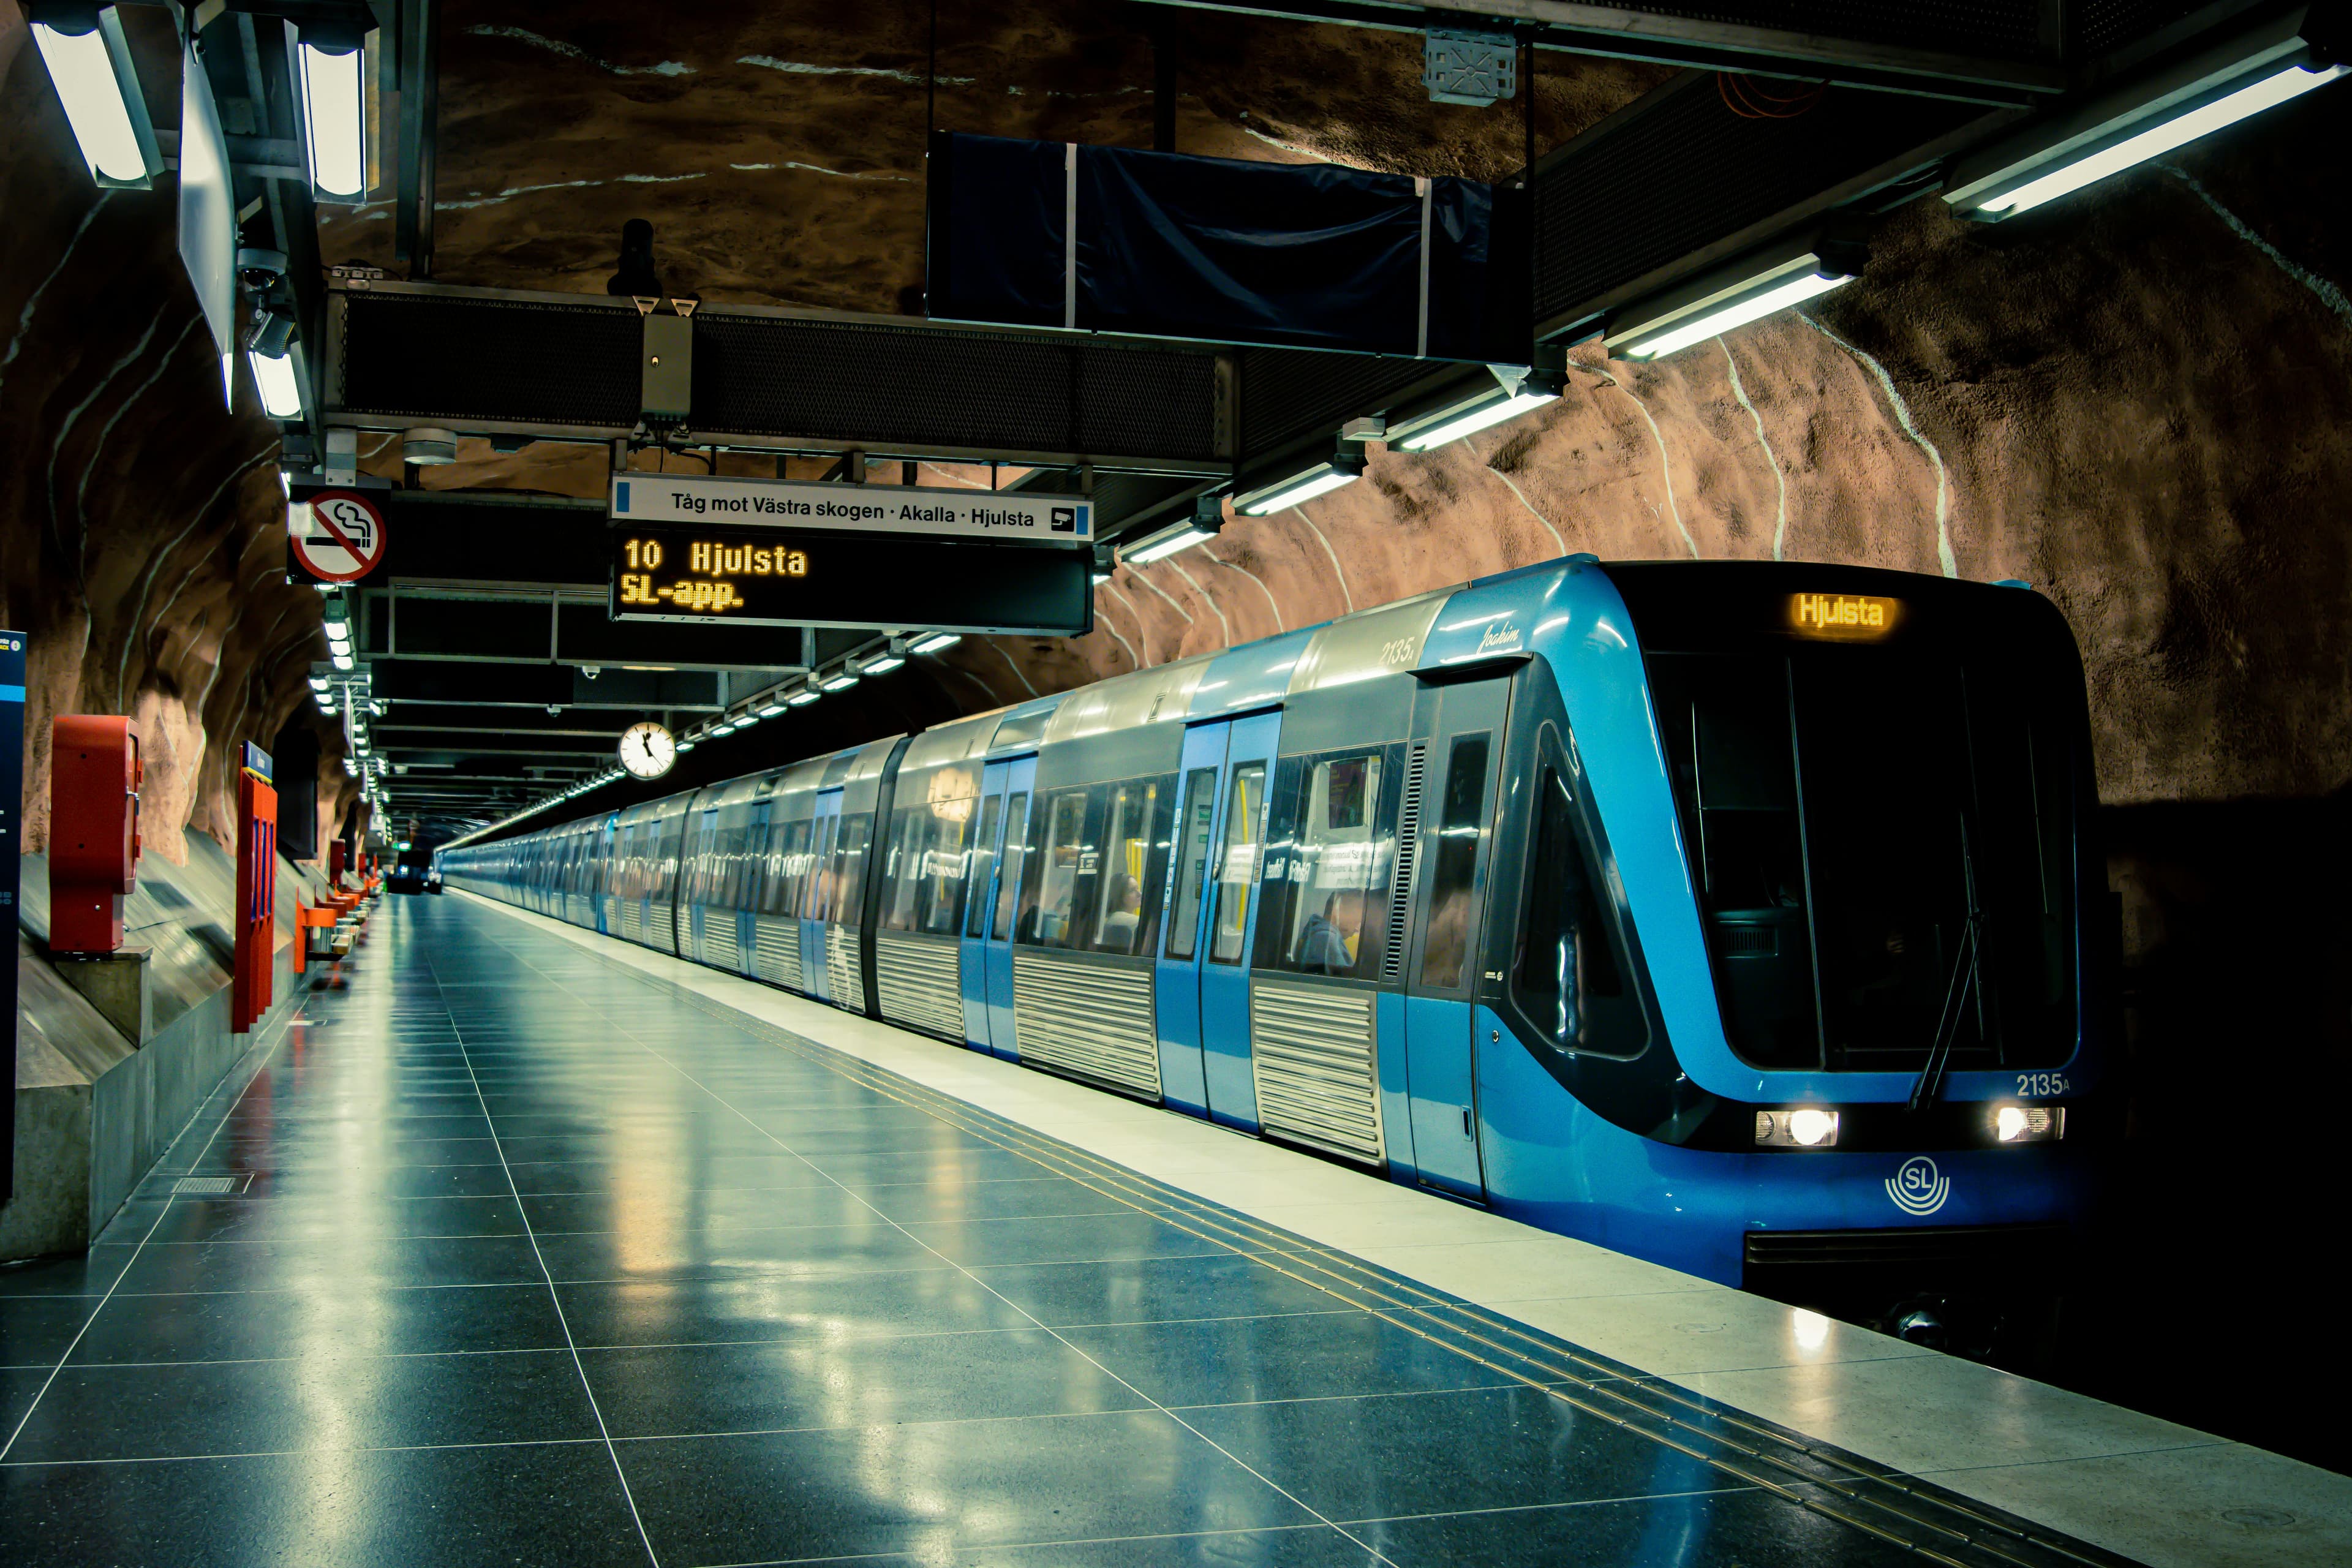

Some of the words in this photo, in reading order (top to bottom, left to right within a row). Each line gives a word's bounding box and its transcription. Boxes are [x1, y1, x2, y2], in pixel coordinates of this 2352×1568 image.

[672, 492, 706, 514] Tåg
[712, 497, 748, 513] mot
[753, 497, 810, 516] Västra
[816, 500, 884, 521] skogen
[899, 505, 956, 522] Akalla
[971, 508, 1035, 528] Hjulsta
[625, 537, 662, 570] 10
[691, 541, 807, 578] Hjulsta
[620, 574, 744, 611] SL-app.
[1800, 594, 1884, 629] Hjulsta
[1476, 620, 1520, 655] Joakim
[1905, 1167, 1932, 1189] SL
